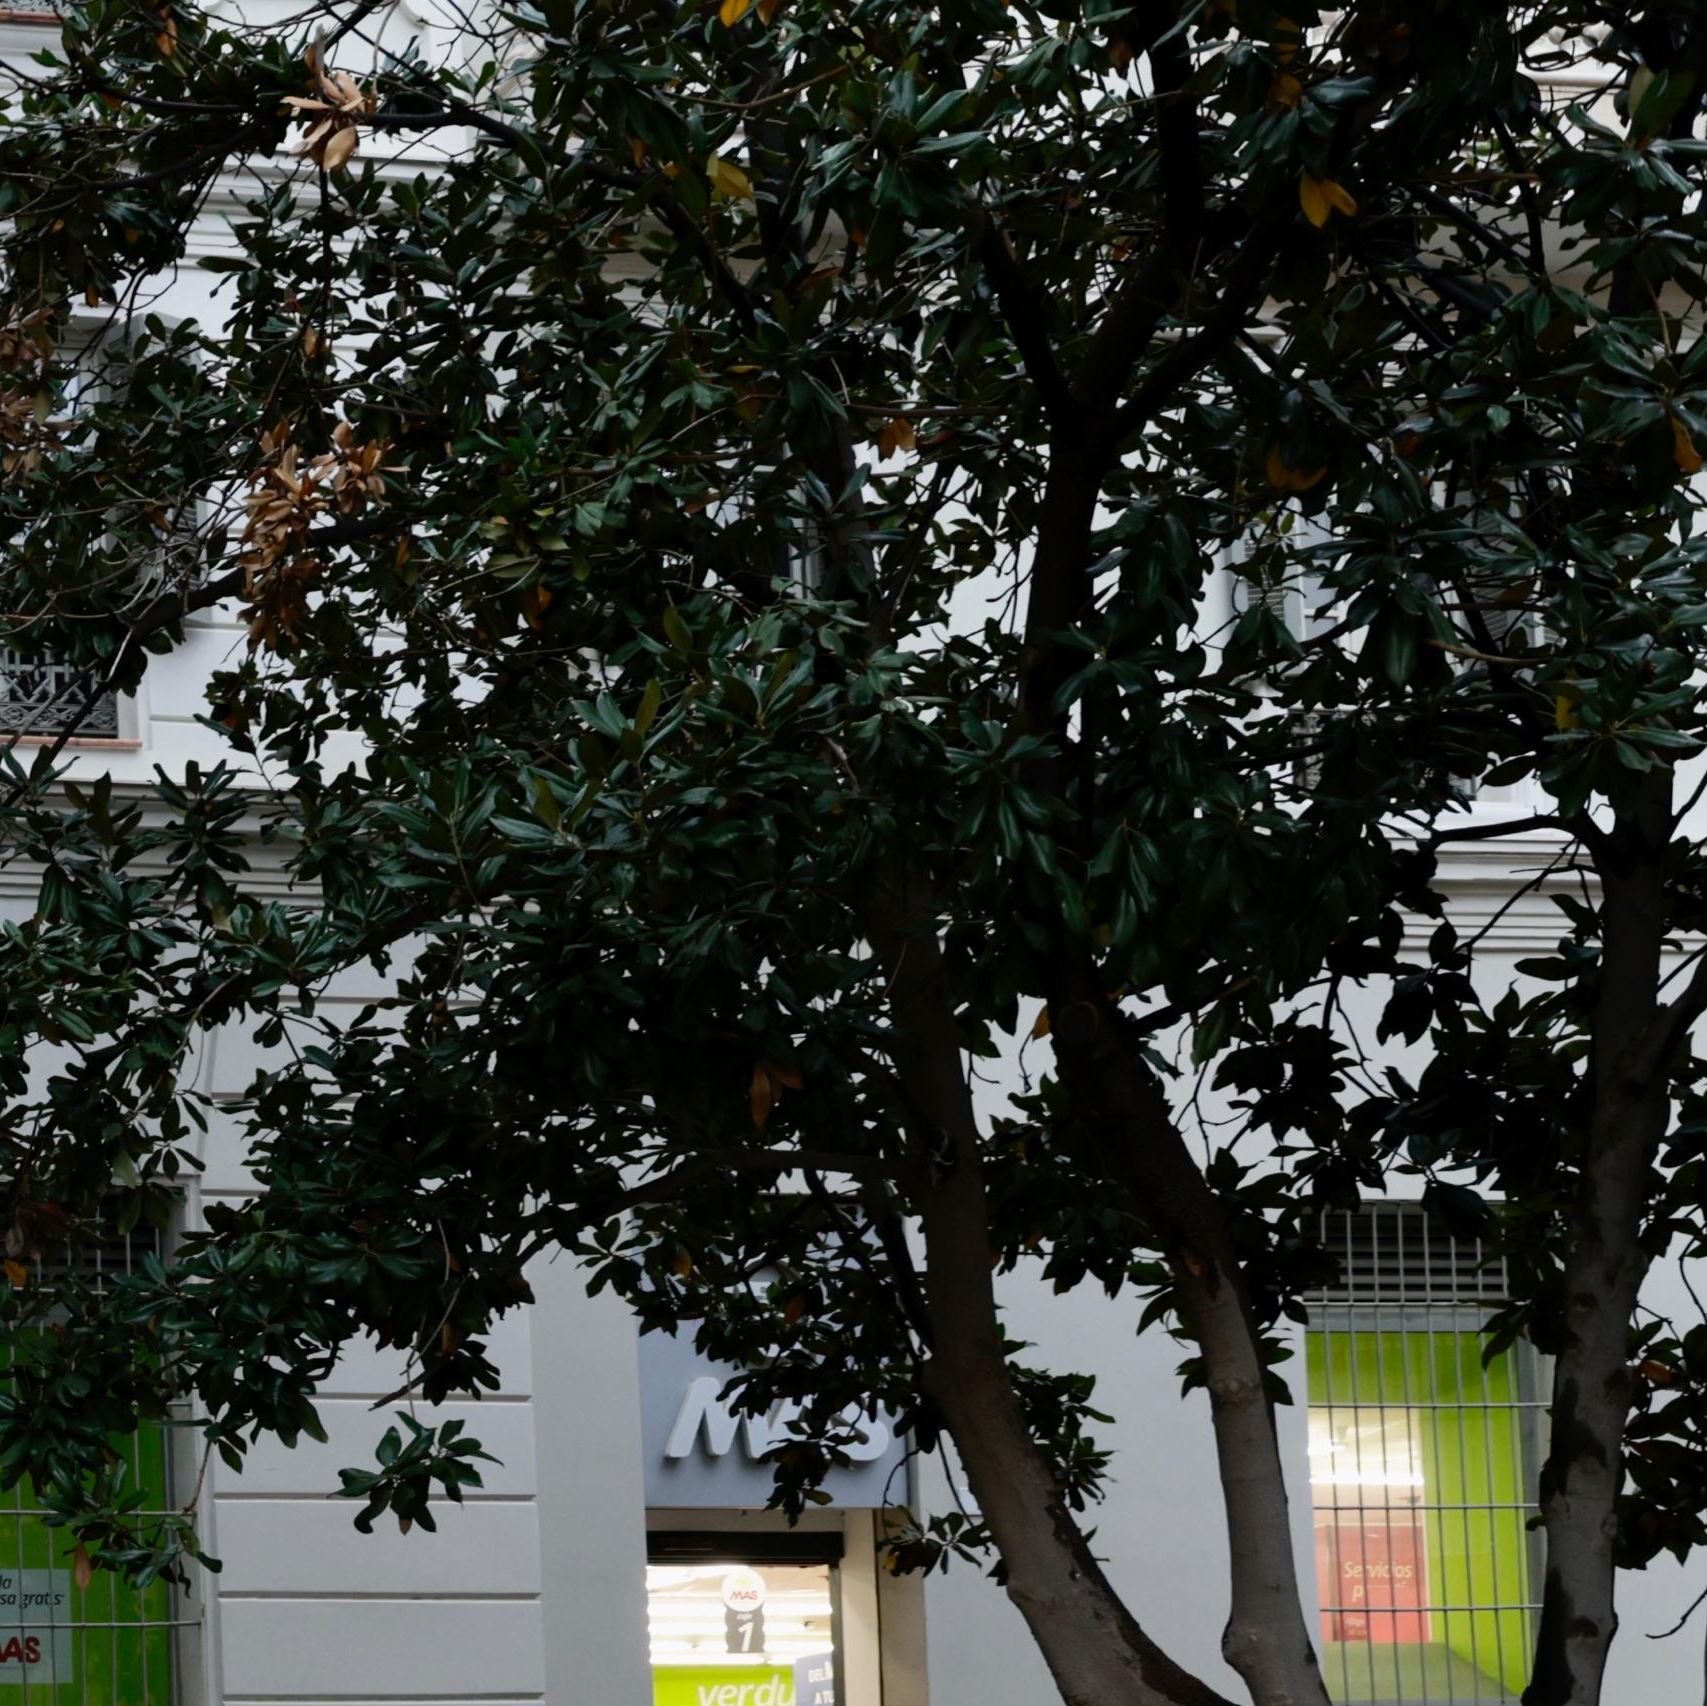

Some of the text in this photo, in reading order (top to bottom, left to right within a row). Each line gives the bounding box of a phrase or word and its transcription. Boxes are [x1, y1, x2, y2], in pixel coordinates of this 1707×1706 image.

[664, 1376, 889, 1462] MS
[1343, 1561, 1413, 1578] Servicios
[730, 1590, 758, 1600] MAS
[738, 1621, 755, 1652] 1
